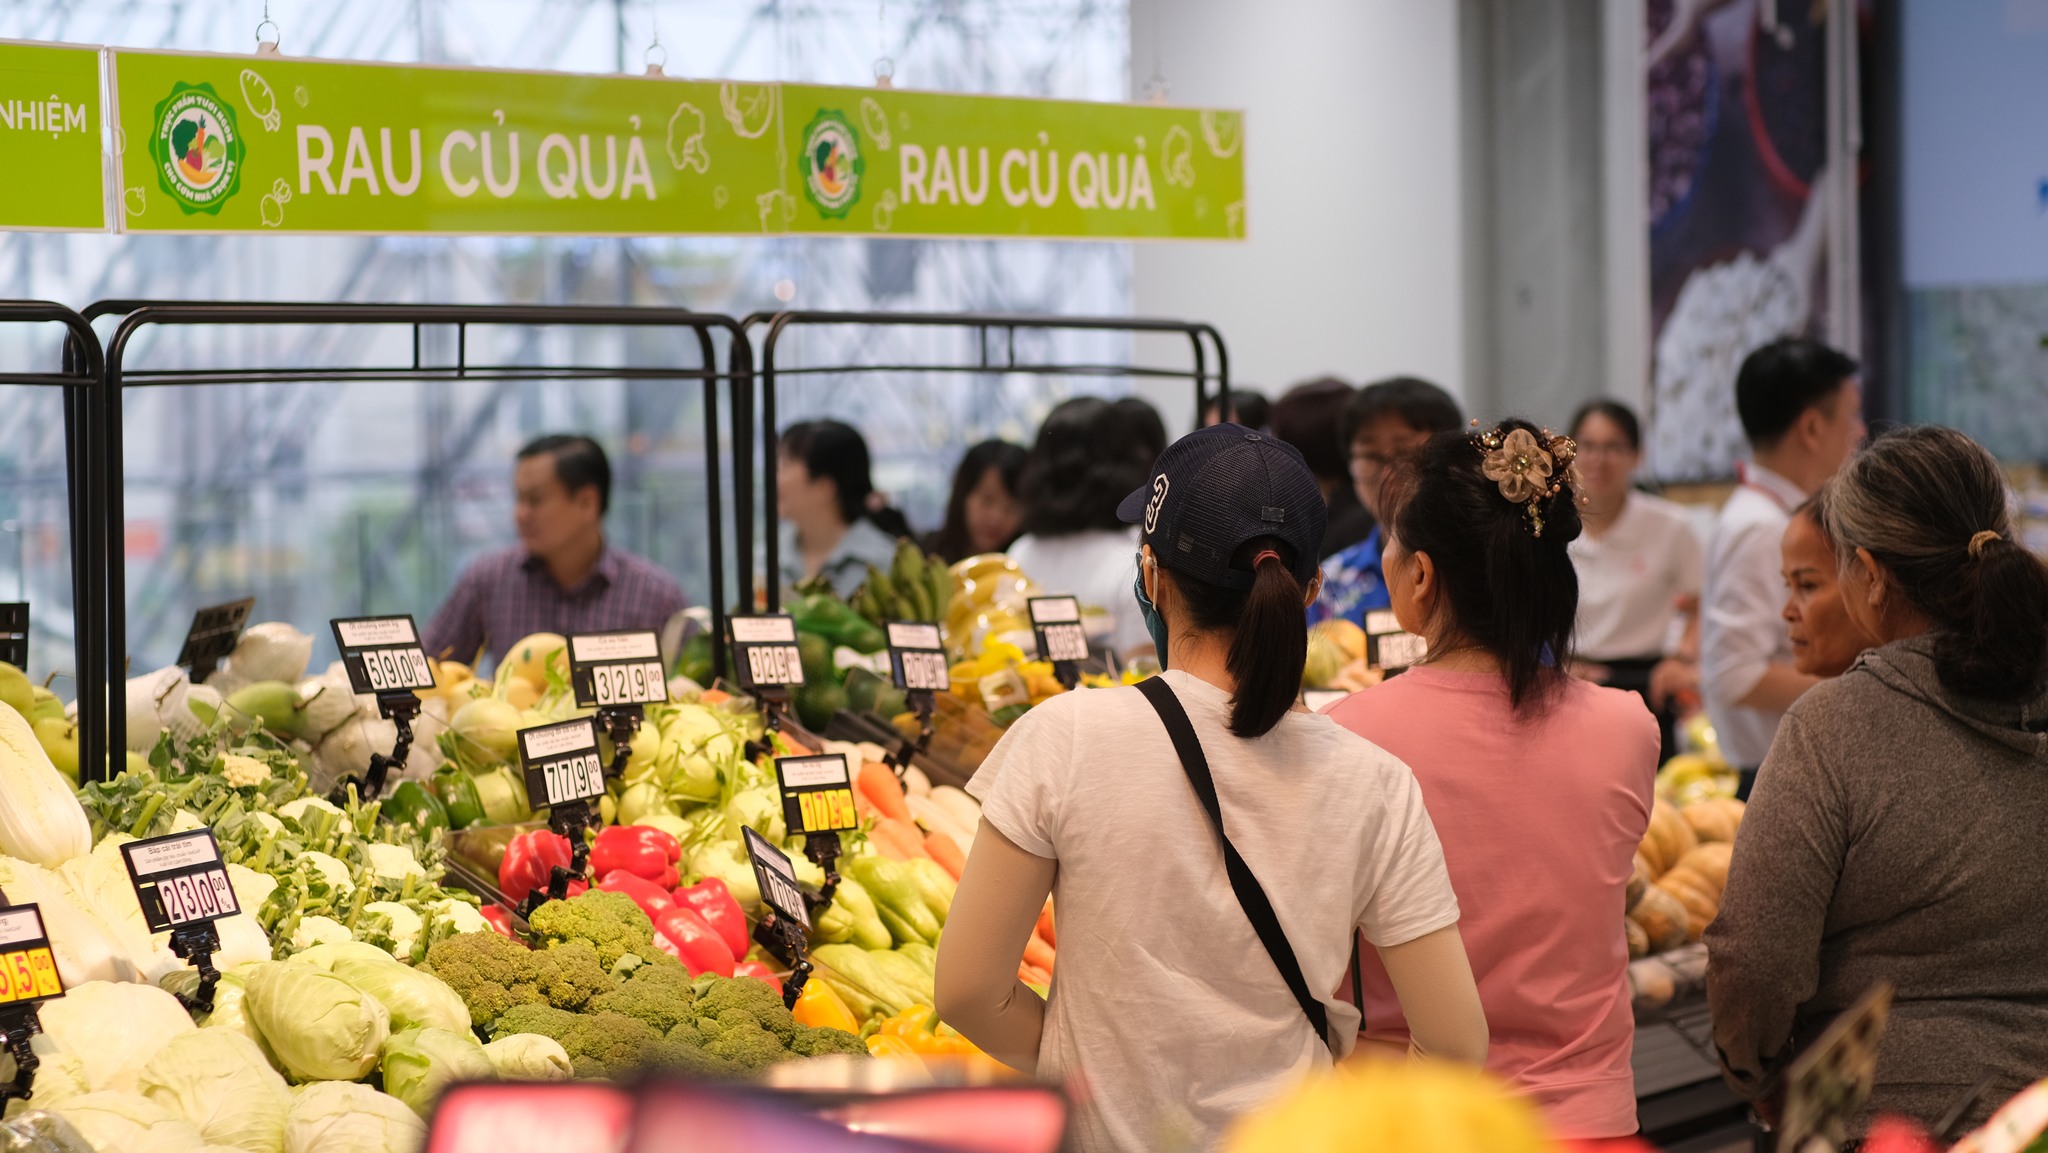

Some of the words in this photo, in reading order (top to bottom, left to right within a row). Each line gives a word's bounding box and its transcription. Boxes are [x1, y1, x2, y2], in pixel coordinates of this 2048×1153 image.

[0, 94, 87, 140] NHIỆM
[296, 124, 422, 197] RAU
[438, 109, 521, 198] CỦ
[536, 115, 656, 200] QUẢ
[899, 143, 989, 206] RAU
[999, 131, 1059, 208] CỦ
[1067, 136, 1156, 210] QUẢ
[1144, 473, 1170, 535] 3
